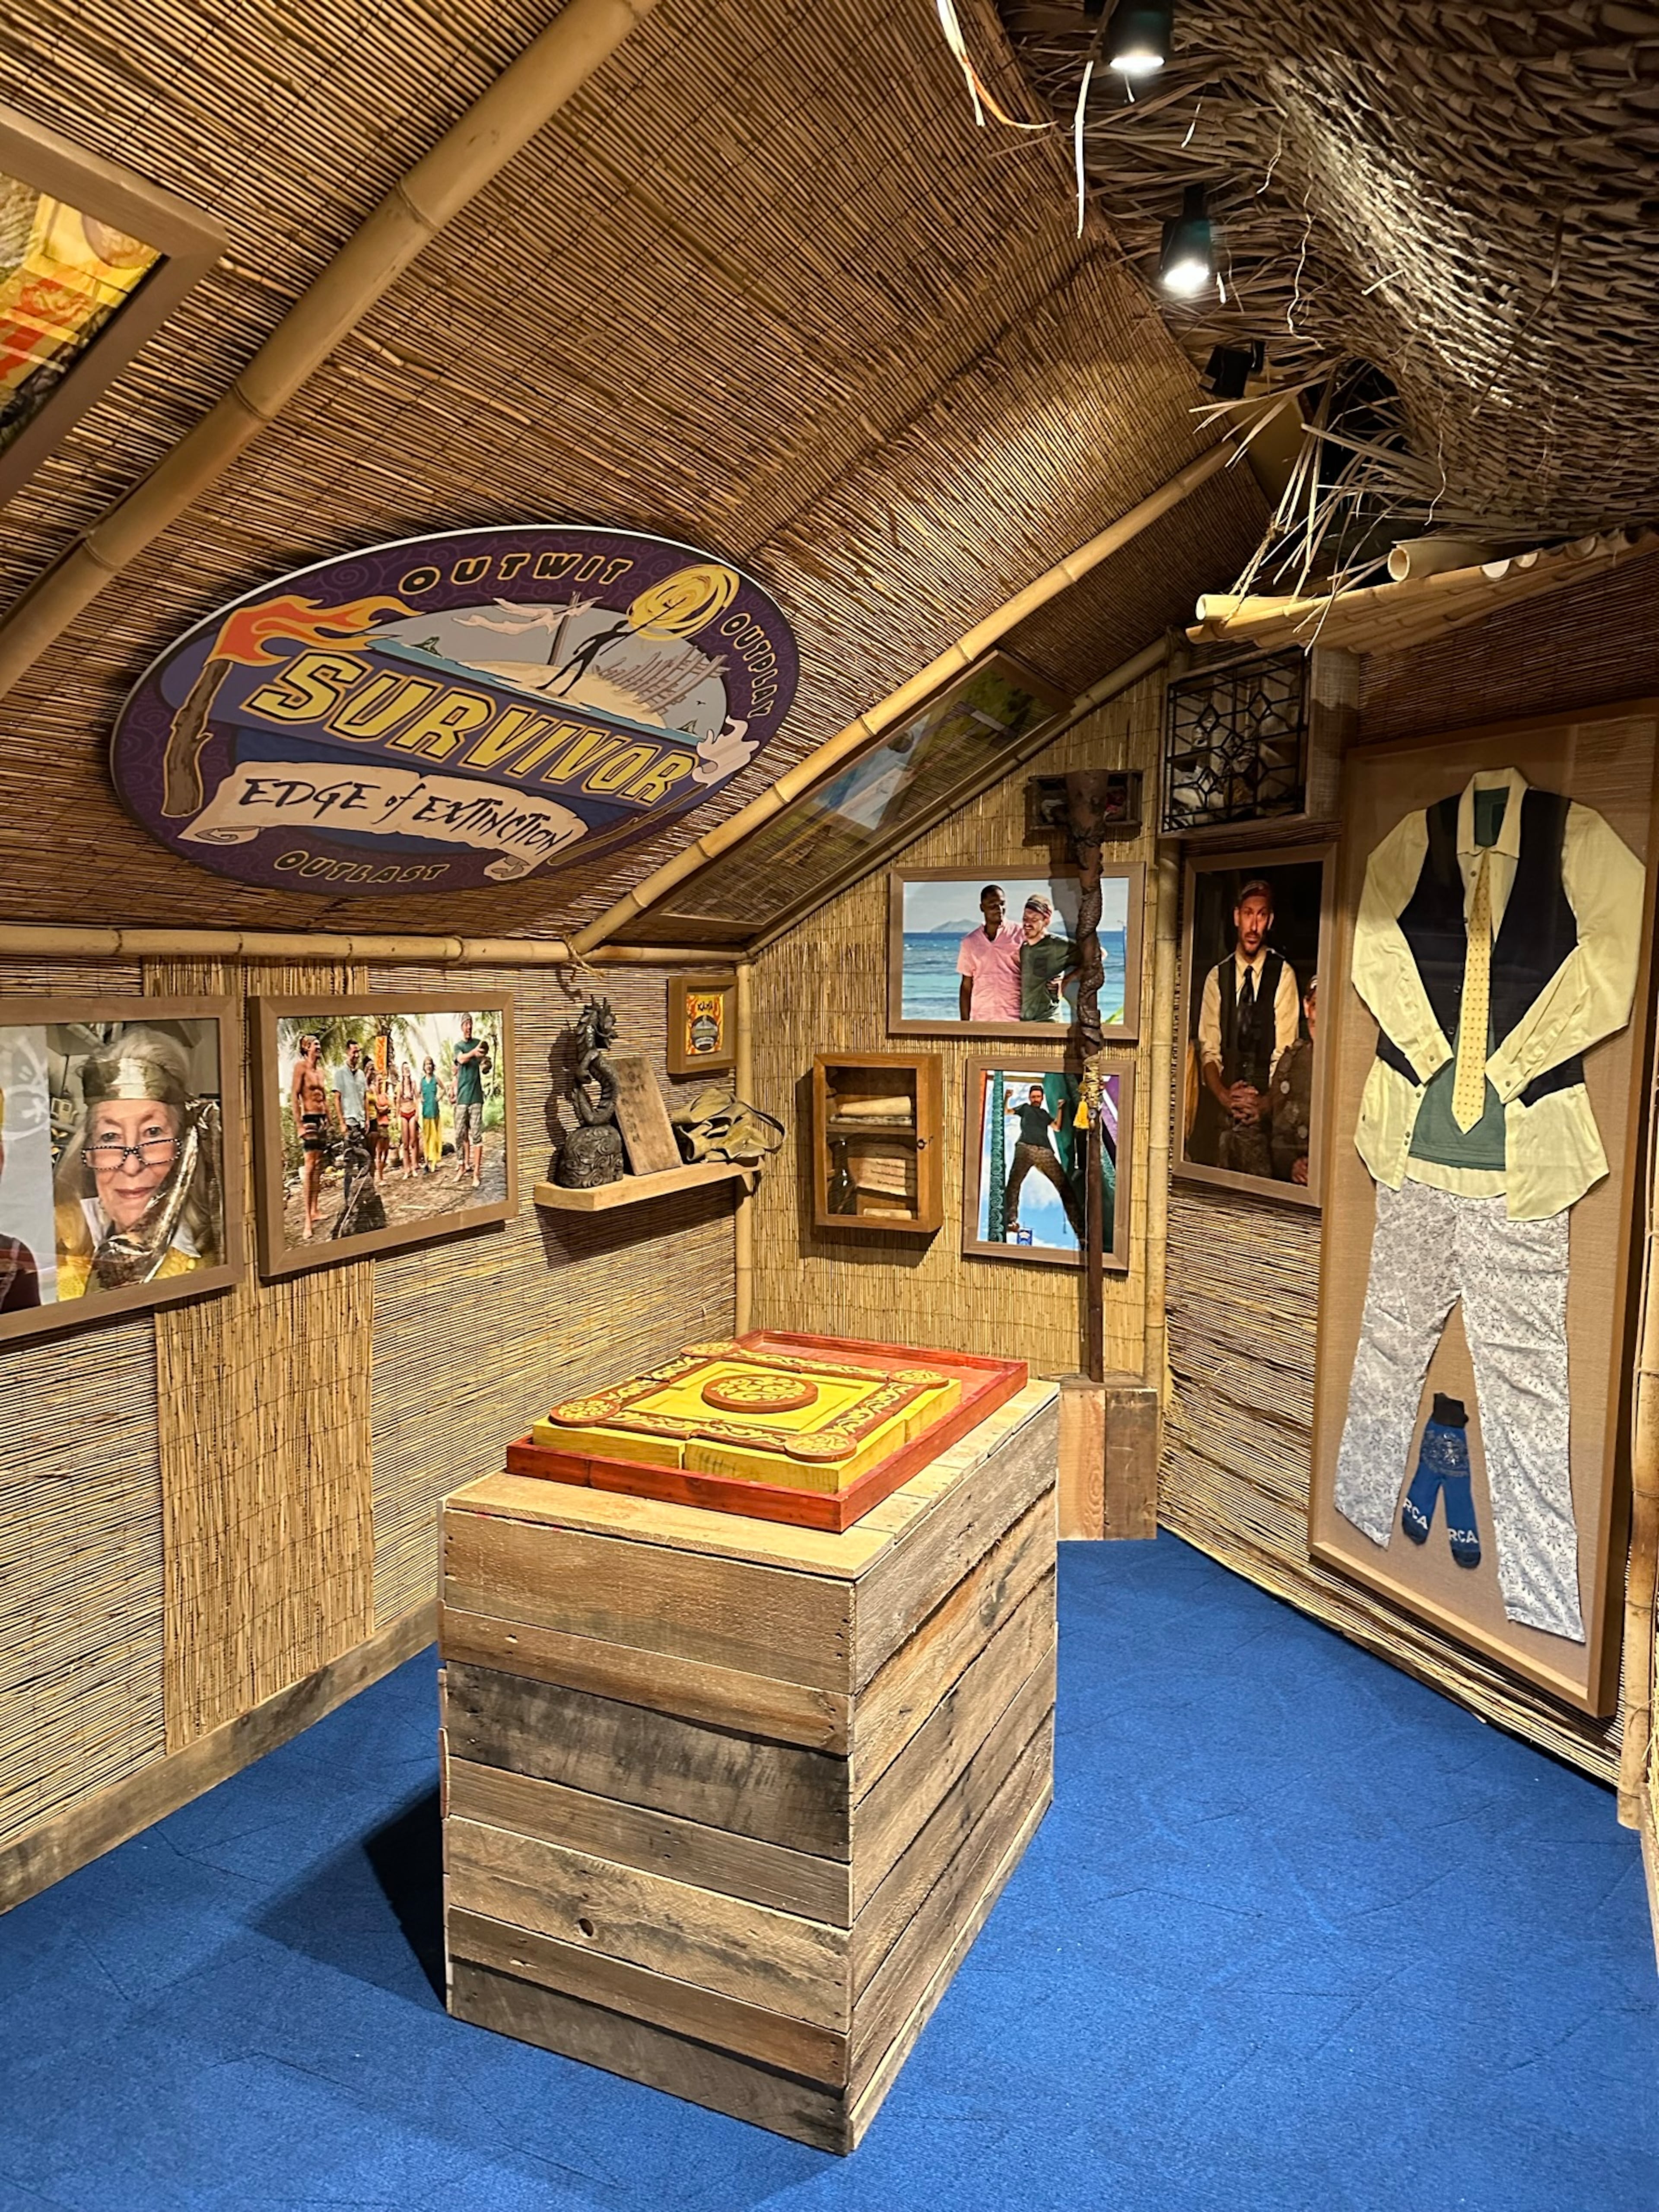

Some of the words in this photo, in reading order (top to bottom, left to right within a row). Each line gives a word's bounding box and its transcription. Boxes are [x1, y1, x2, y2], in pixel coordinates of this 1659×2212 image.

[398, 552, 633, 596] OUTWIT
[721, 613, 779, 718] OUTPLAY
[239, 650, 699, 807] SURVIVOR
[238, 778, 382, 819] EDGE
[373, 783, 426, 825] of
[413, 797, 575, 856] EXTINCTION
[273, 851, 451, 883] OUTLAST
[1403, 1497, 1428, 1530] RCA
[1447, 1528, 1478, 1544] RCA
